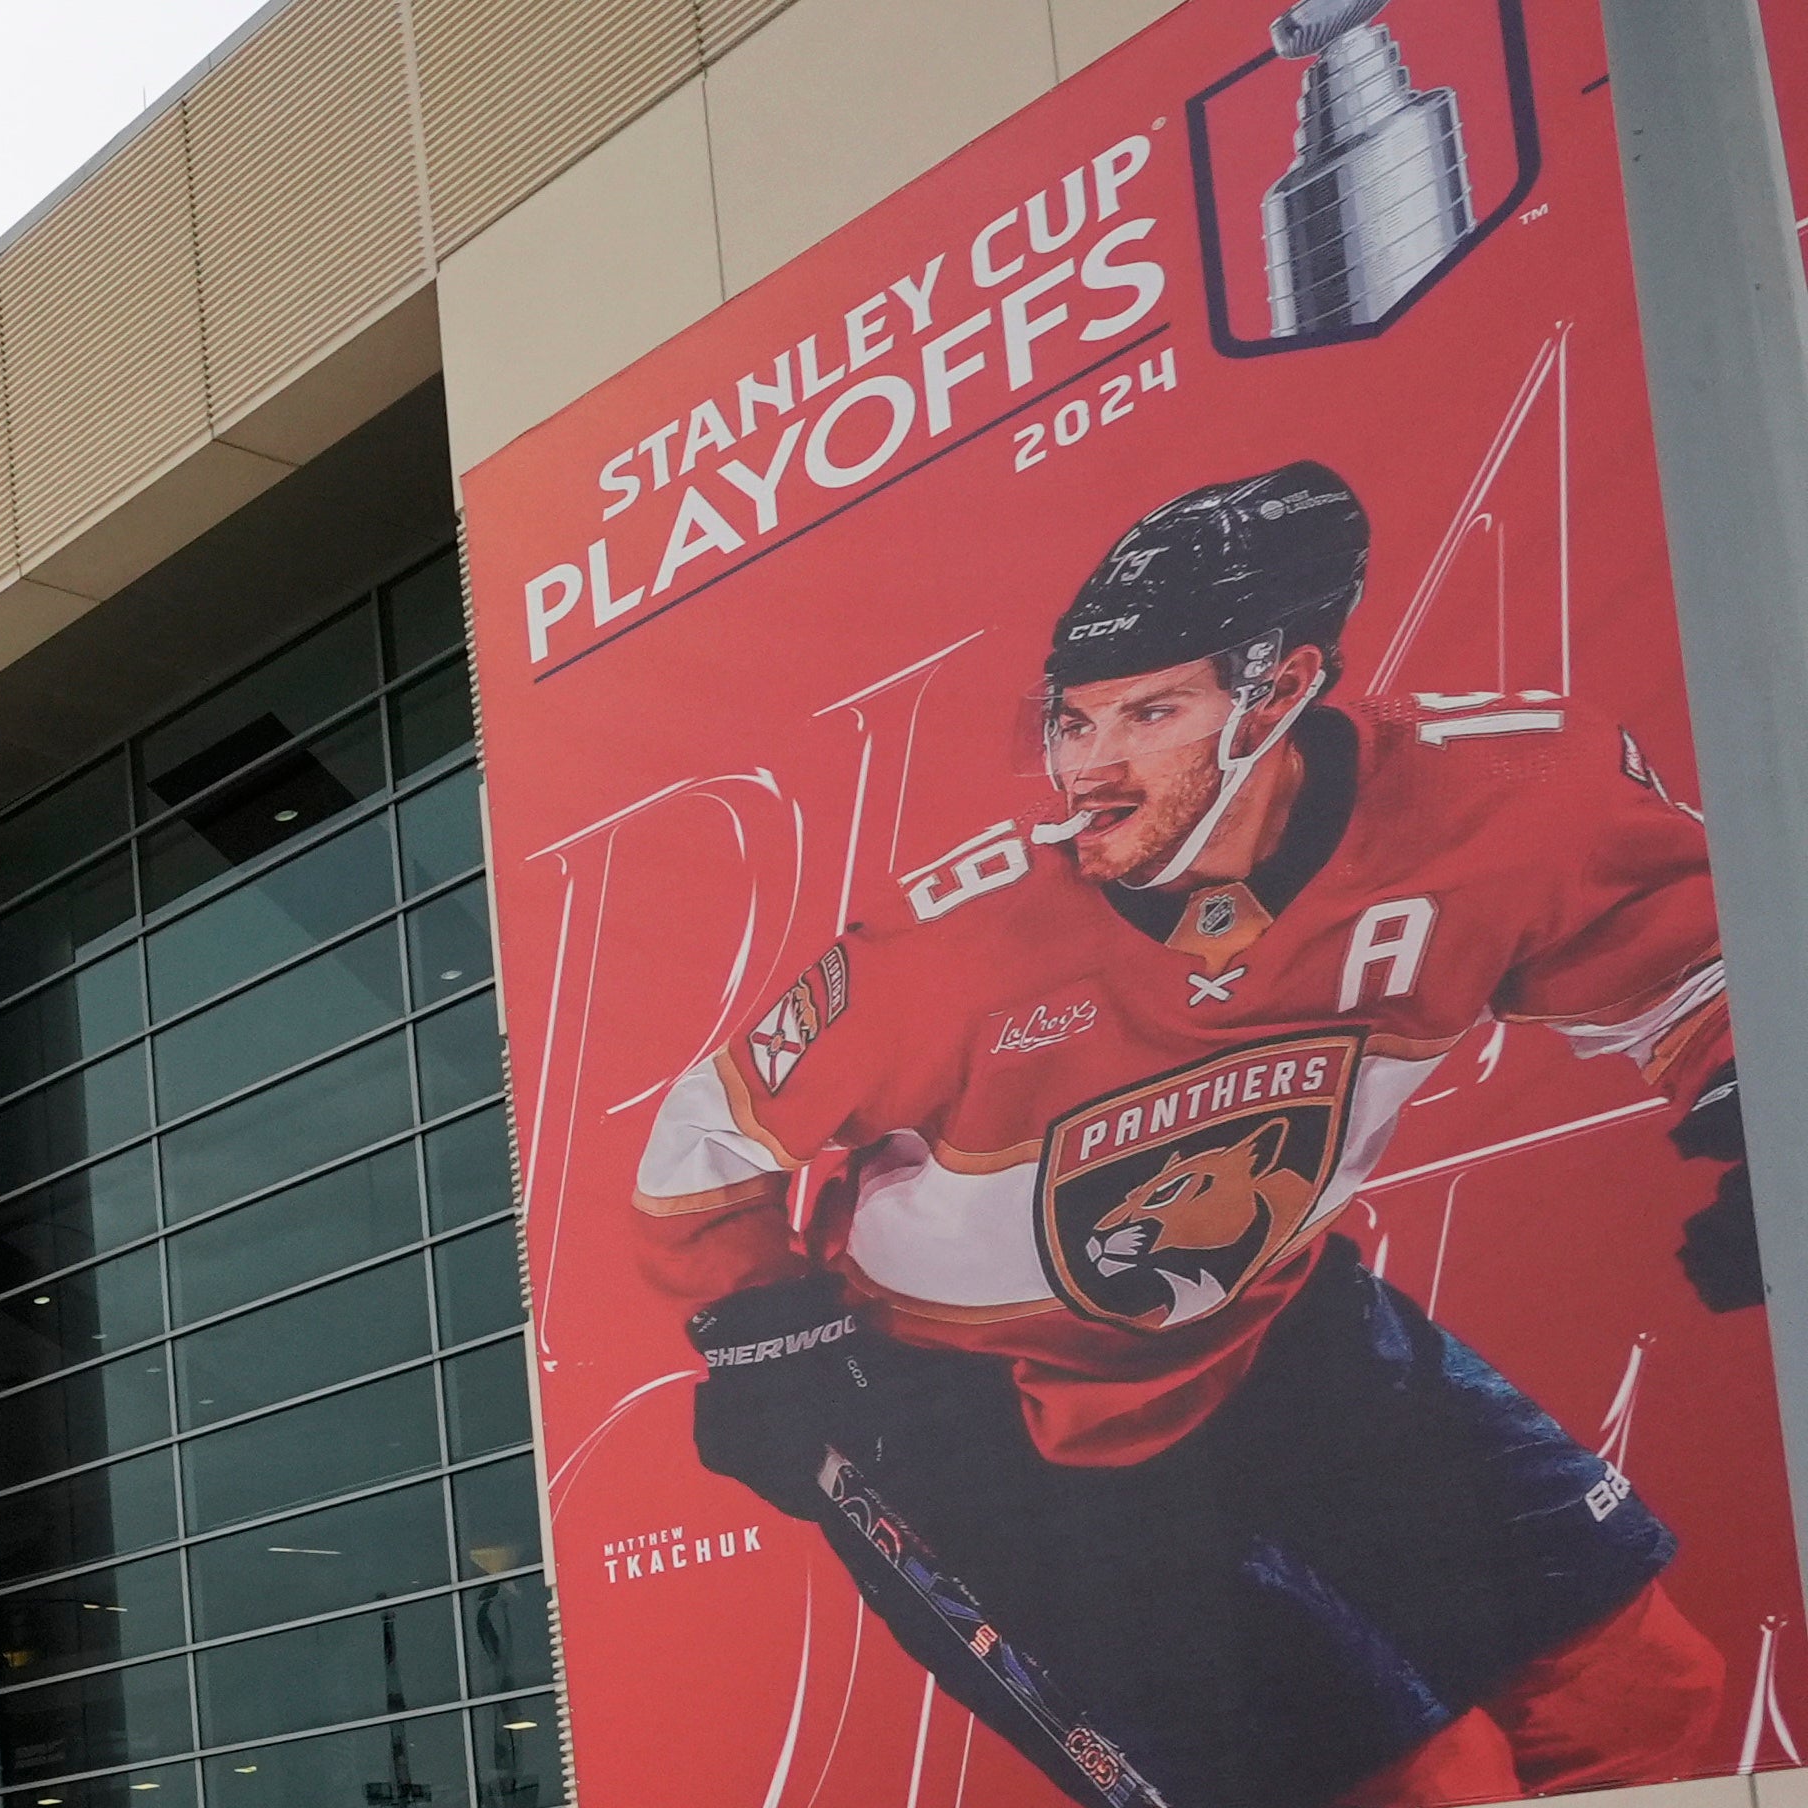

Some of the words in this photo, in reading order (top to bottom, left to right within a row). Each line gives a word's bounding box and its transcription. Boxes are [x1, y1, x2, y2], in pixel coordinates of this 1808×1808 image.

[598, 254, 944, 520] STANLEY
[970, 135, 1150, 288] CUP
[524, 218, 1165, 663] PLAYOFFS
[1013, 348, 1176, 473] 2024
[1069, 614, 1139, 641] CCM
[1338, 896, 1438, 1014] A
[990, 1000, 1097, 1055] LaCroix
[1079, 1056, 1328, 1160] PANTHERS
[603, 1526, 684, 1557] MATTHEW
[605, 1526, 762, 1583] TKACHUK
